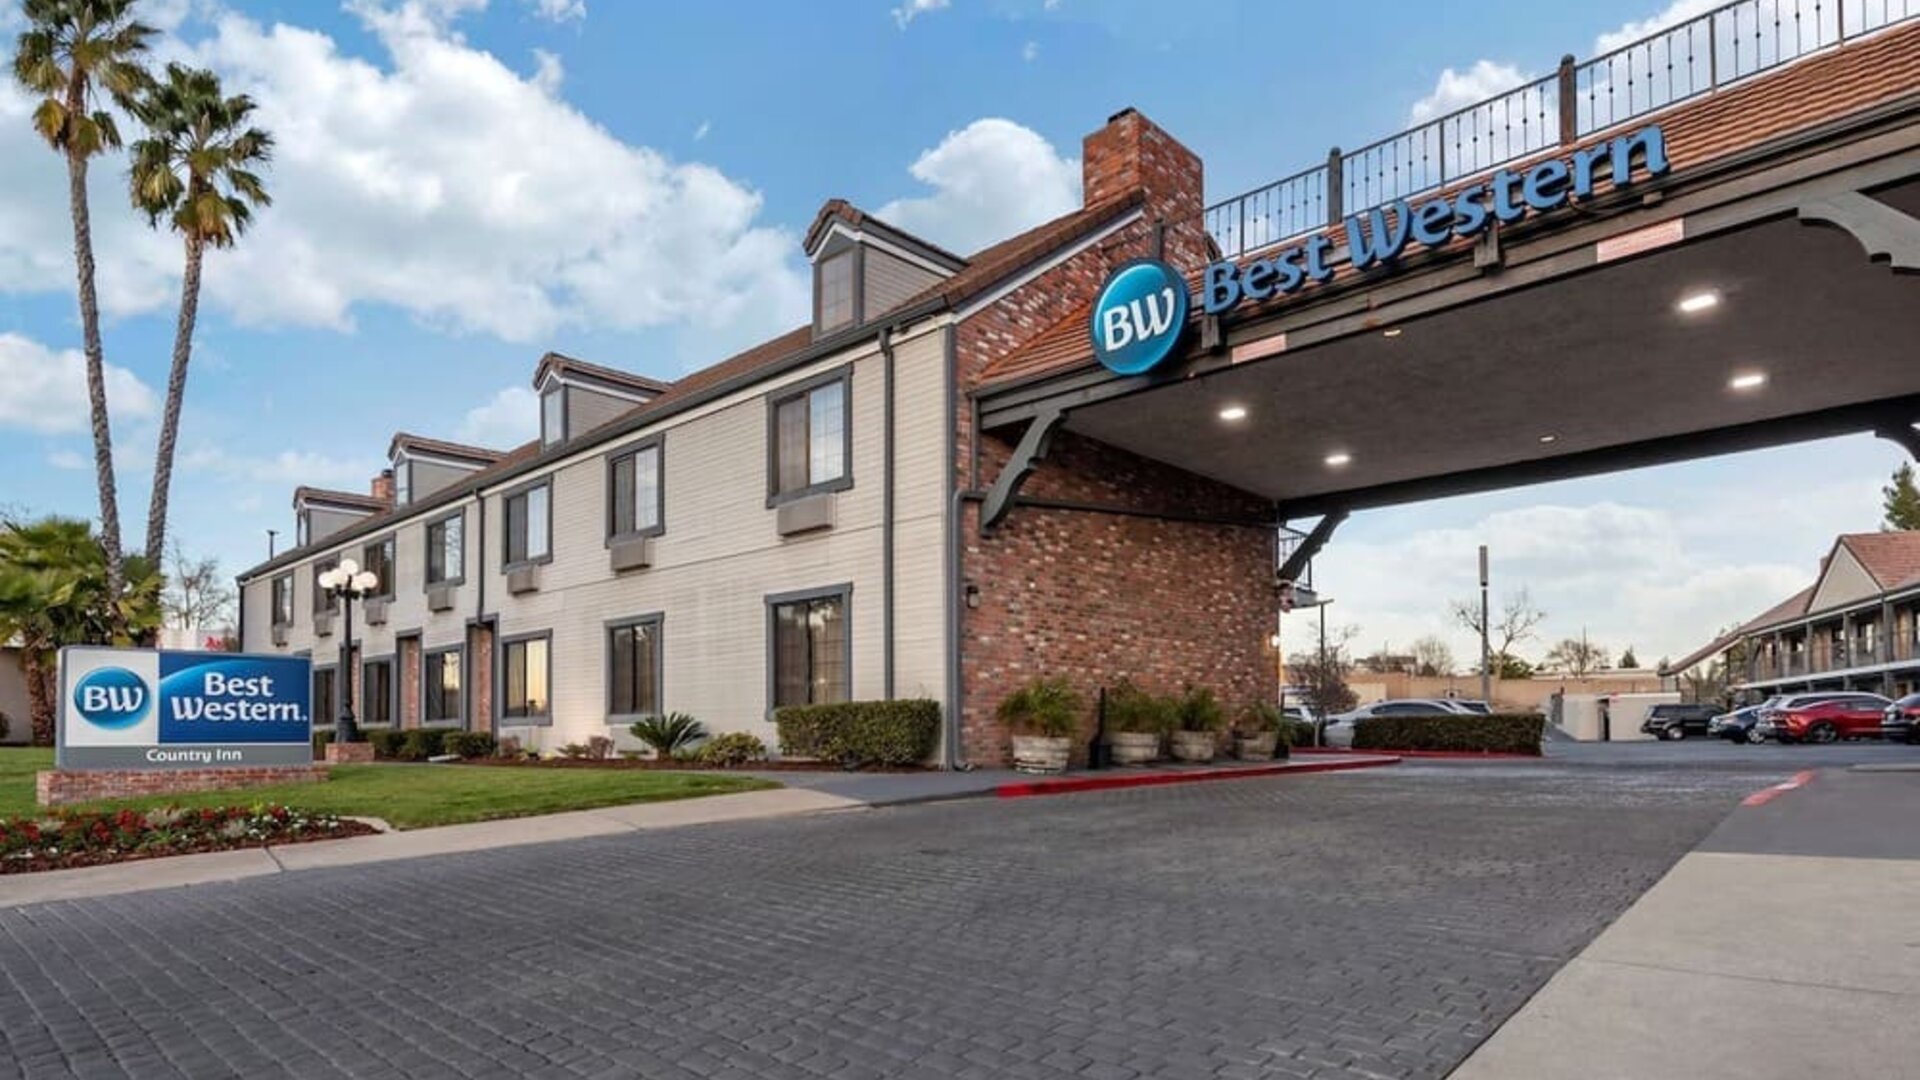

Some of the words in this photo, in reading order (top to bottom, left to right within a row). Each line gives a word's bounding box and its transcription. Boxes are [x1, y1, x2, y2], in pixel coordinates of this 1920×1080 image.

[1203, 231, 1334, 313] Best
[1346, 125, 1668, 270] Western
[1103, 287, 1175, 352] BW
[205, 672, 274, 696] Best
[83, 686, 144, 711] BW
[146, 749, 211, 763] Country
[216, 749, 242, 762] Inn
